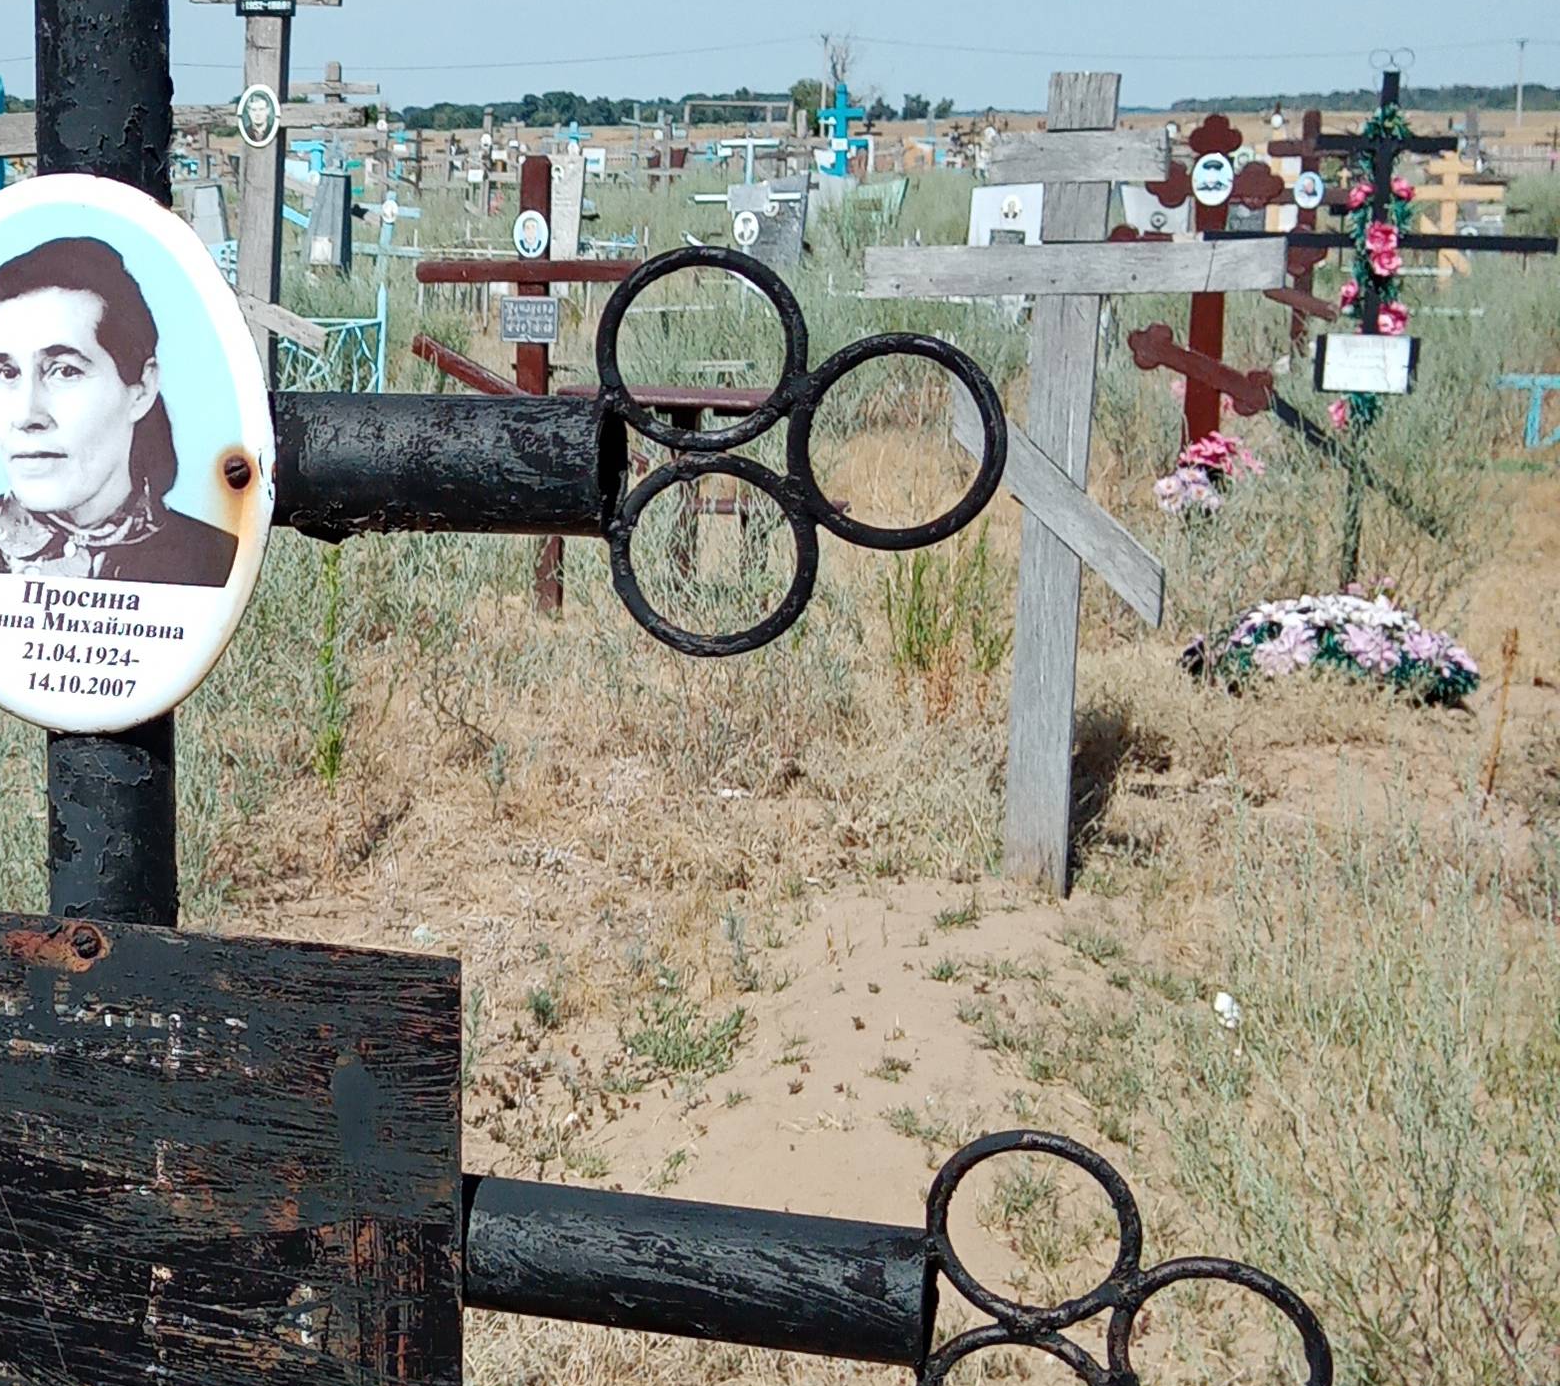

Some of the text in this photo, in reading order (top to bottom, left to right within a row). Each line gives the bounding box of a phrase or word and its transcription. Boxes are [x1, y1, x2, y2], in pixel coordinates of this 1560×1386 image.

[21, 580, 141, 611] Просина
[41, 611, 185, 640] Михайловна
[21, 641, 141, 667] 21.04.1924-
[27, 672, 137, 699] 14.10.2007
